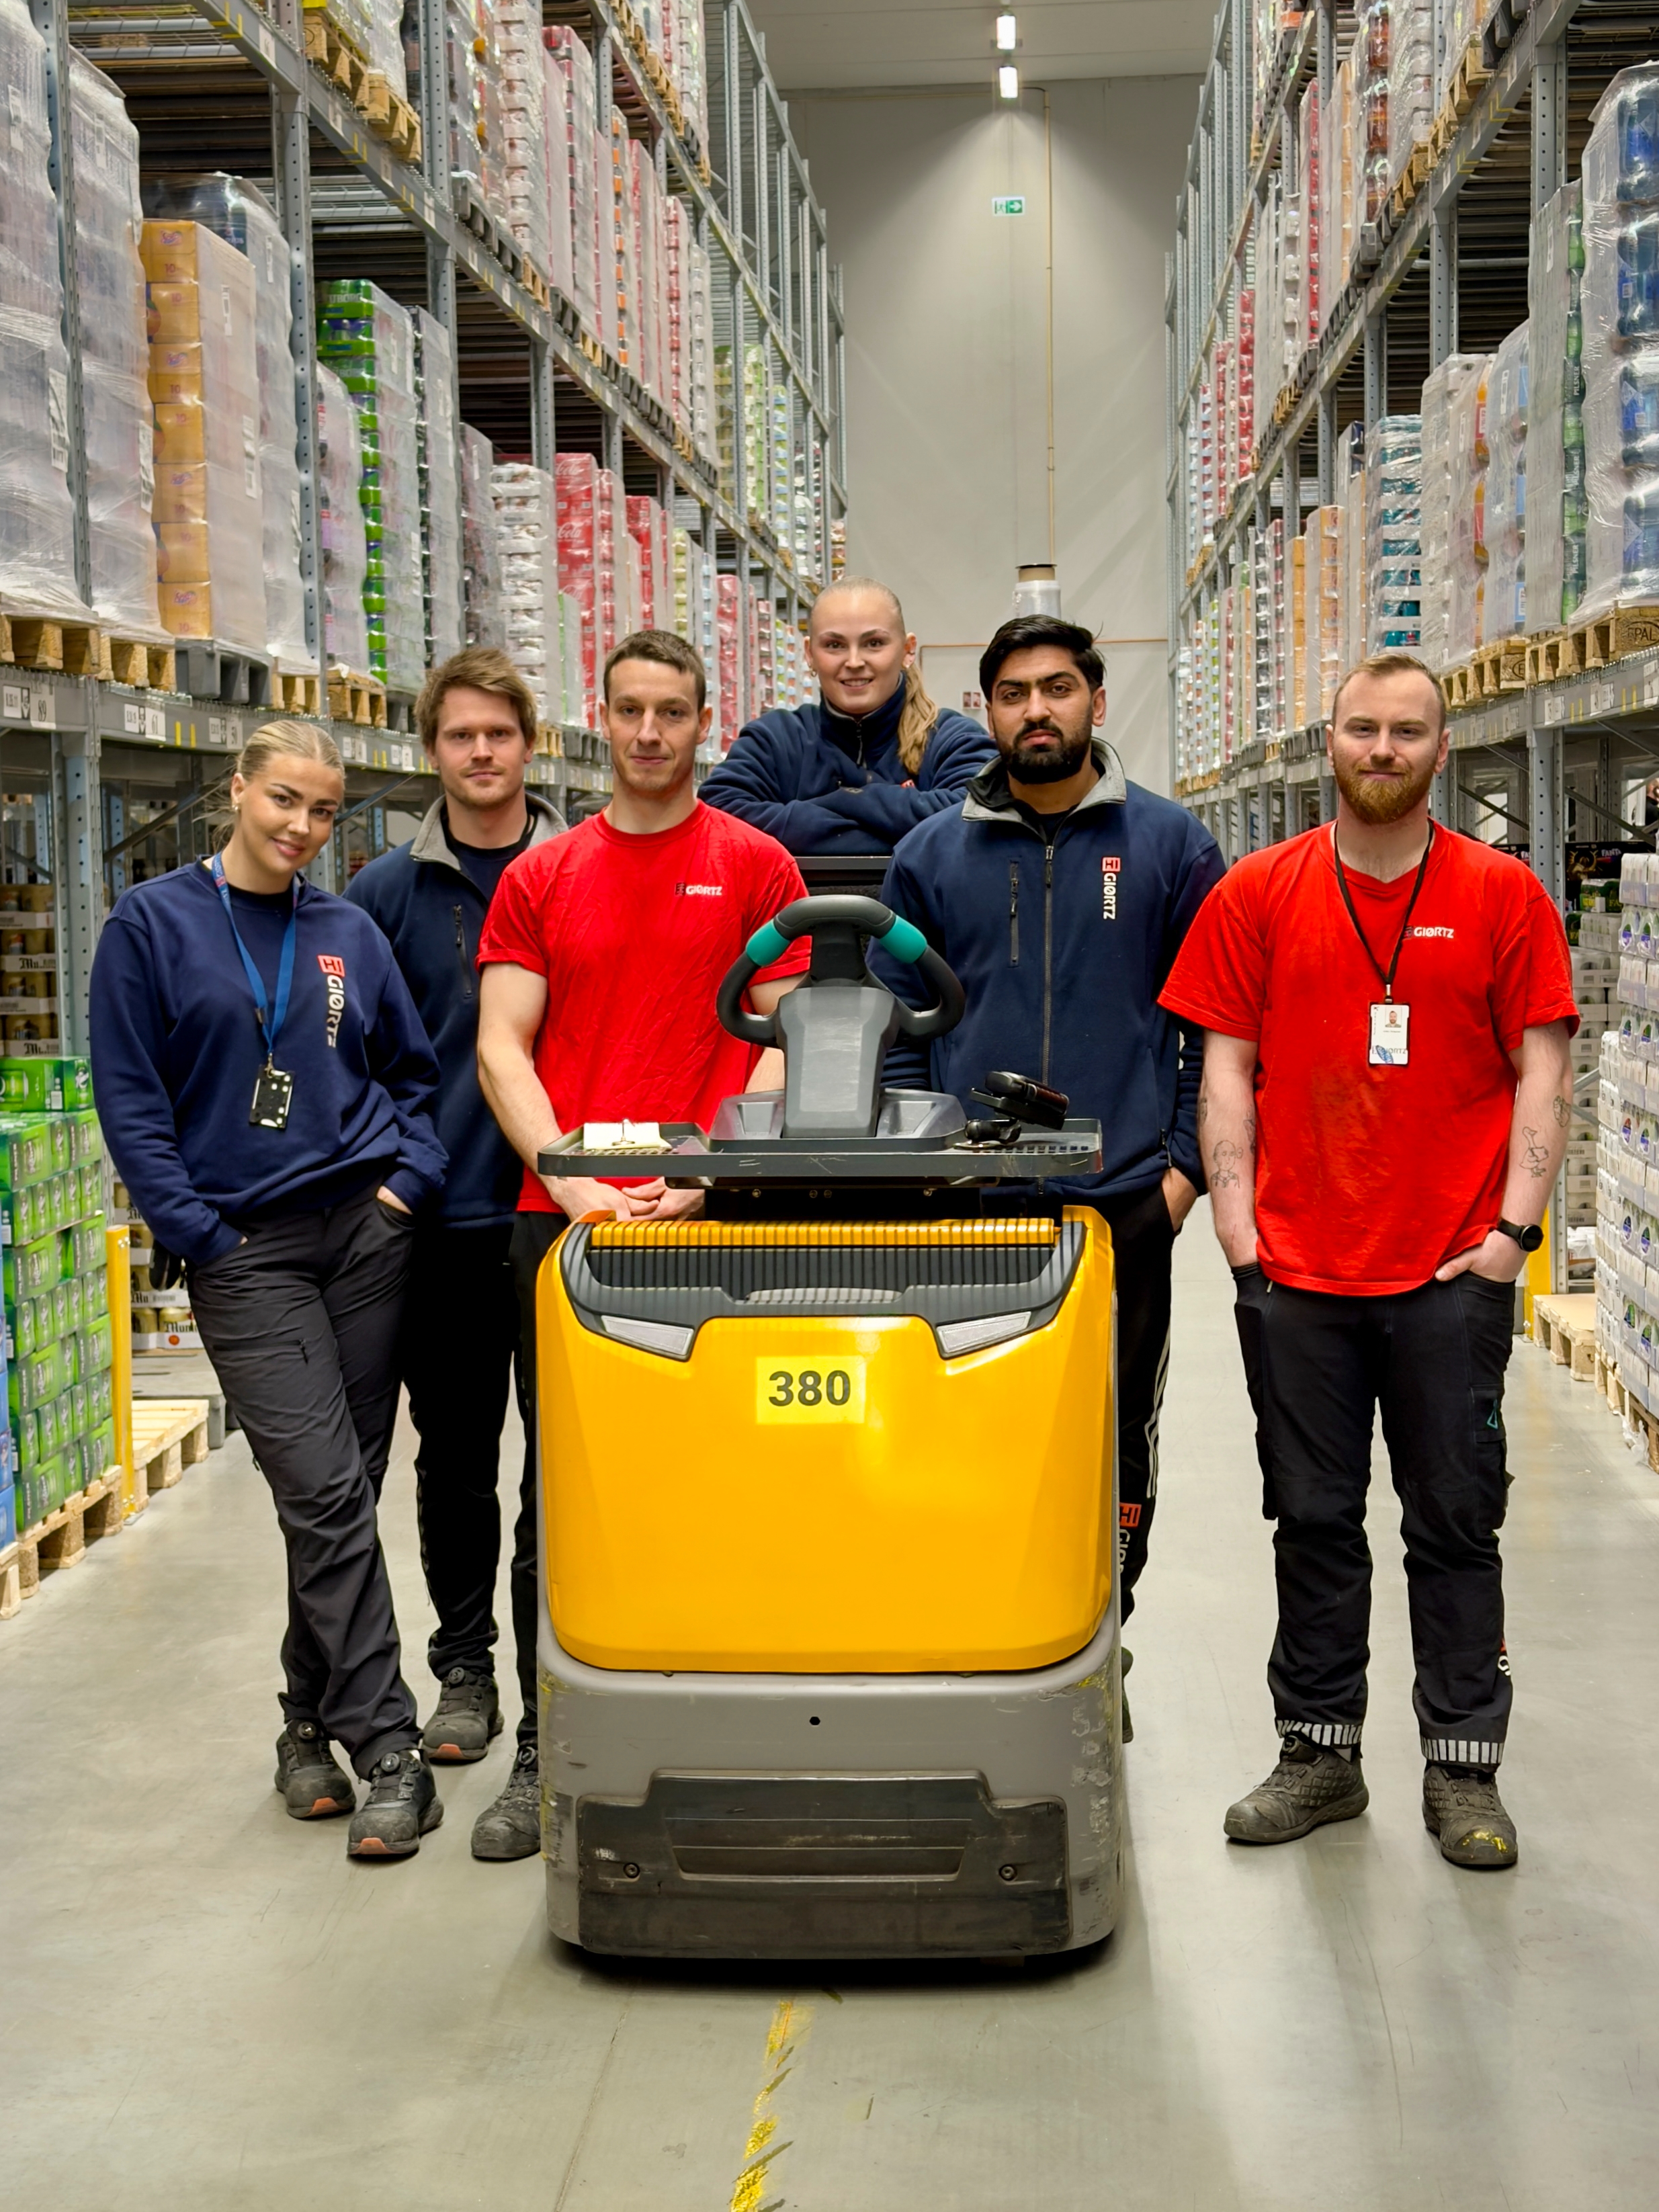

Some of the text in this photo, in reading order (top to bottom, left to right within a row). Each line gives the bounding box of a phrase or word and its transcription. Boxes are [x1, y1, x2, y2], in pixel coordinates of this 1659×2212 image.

[1601, 848, 1621, 857] FANTA
[1103, 872, 1116, 920] GIØRTZ
[1414, 927, 1454, 939] GIØRTZ
[769, 1370, 851, 1406] 380
